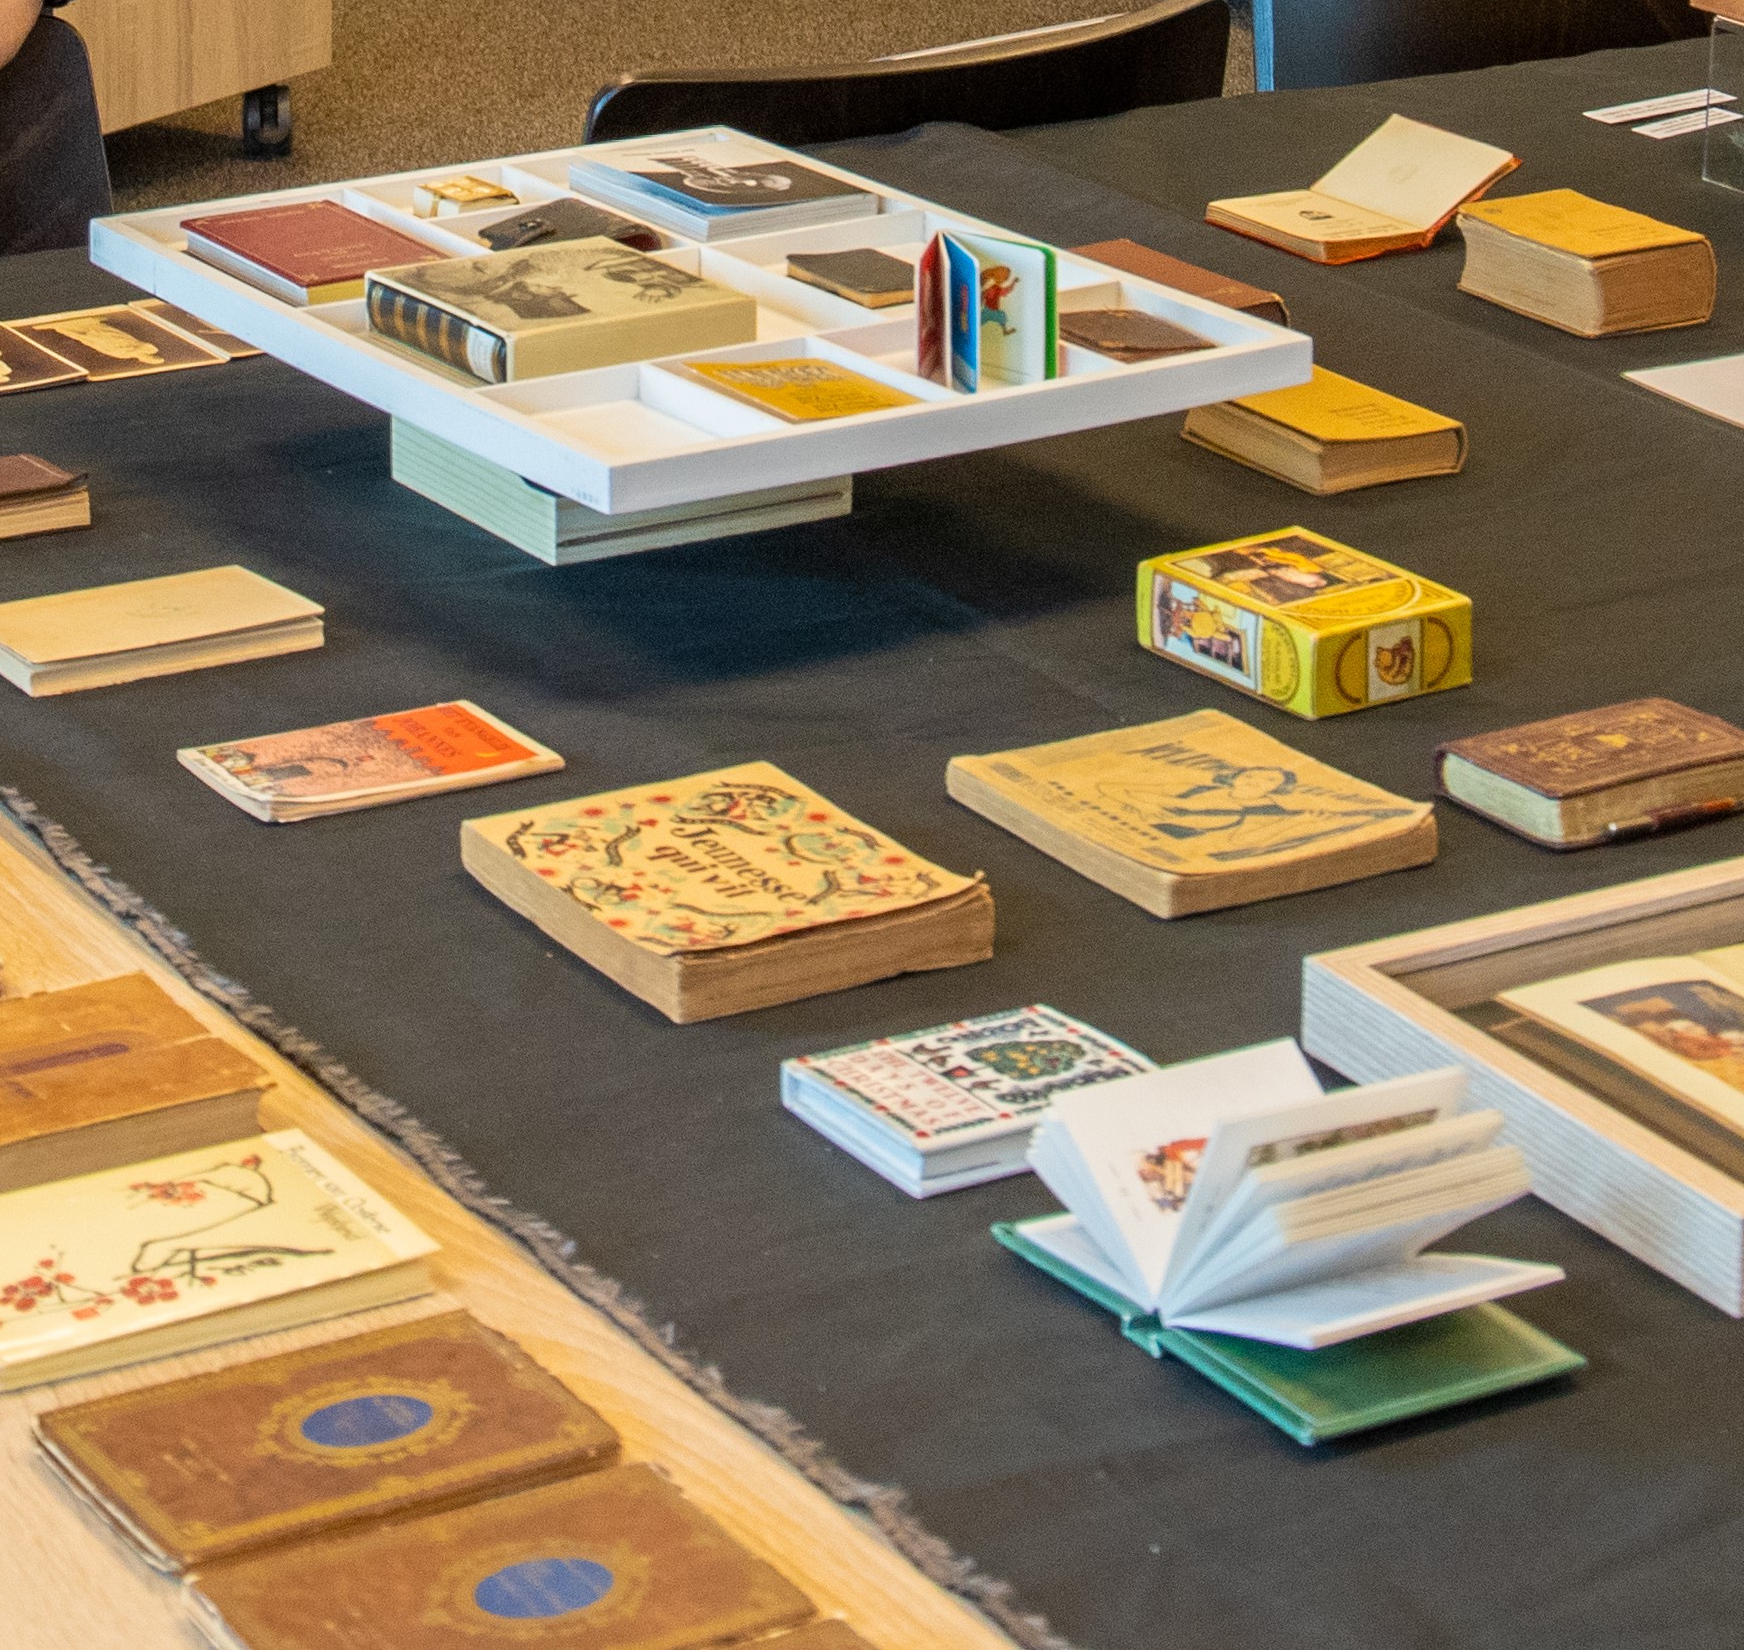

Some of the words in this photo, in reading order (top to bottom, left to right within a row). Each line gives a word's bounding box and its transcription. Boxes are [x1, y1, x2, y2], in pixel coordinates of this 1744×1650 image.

[646, 846, 719, 873] qui
[701, 874, 758, 899] vit
[671, 827, 807, 901] Jeunesse
[825, 1058, 941, 1126] CHRISTMAS
[911, 1069, 986, 1115] TWELVE
